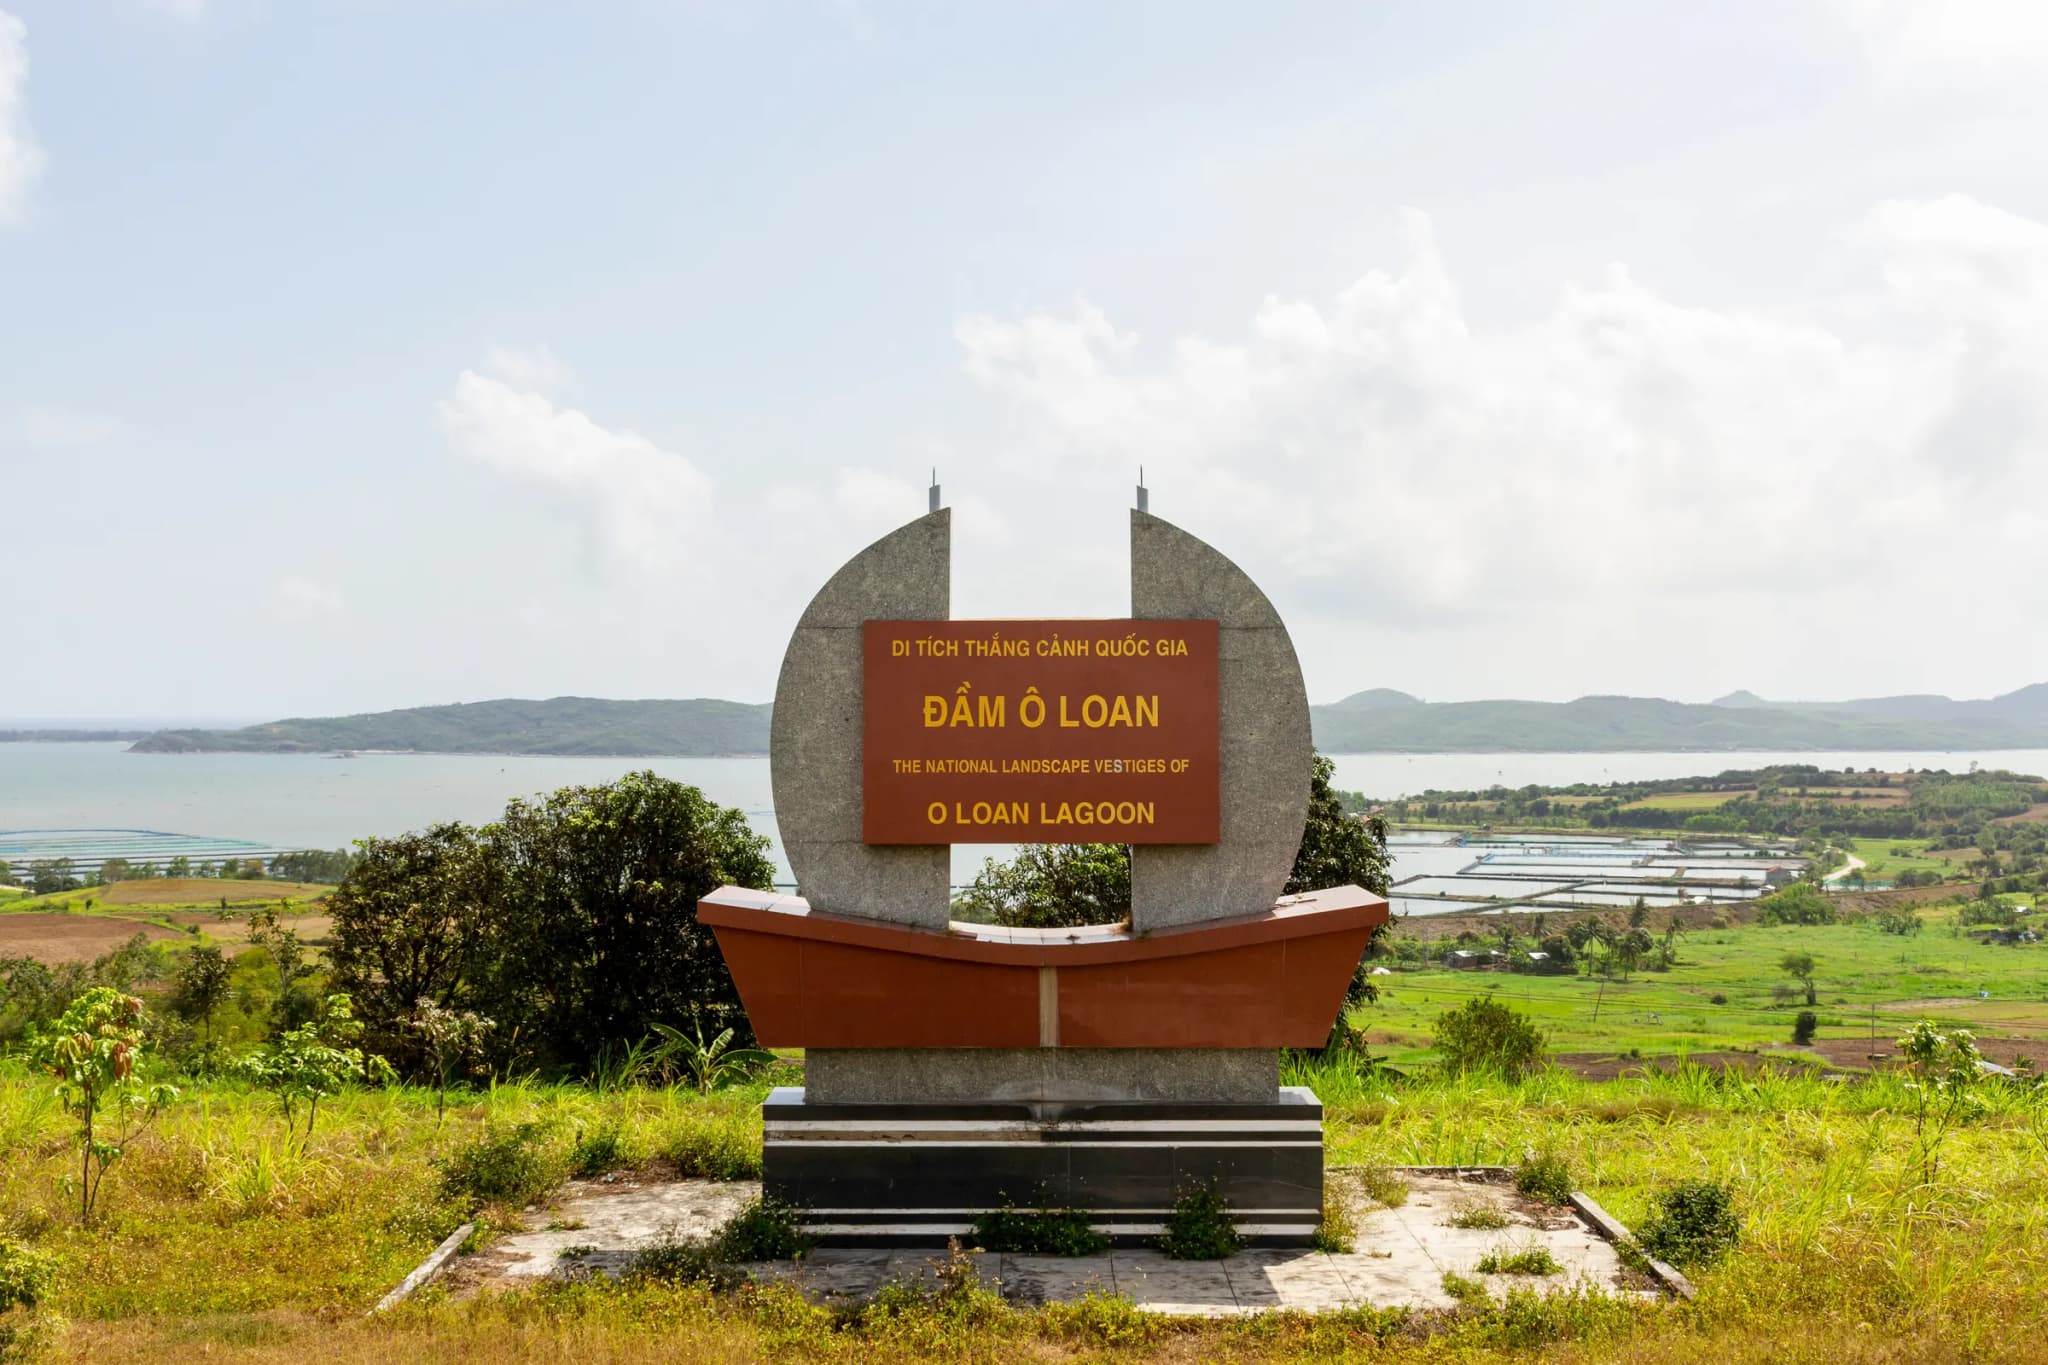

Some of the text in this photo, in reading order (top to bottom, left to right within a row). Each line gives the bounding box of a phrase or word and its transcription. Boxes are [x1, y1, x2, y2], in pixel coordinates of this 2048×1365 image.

[893, 632, 1188, 656] DI TÍCH THẮNG CẢNH QUỐC GIA
[923, 681, 1158, 728] ĐẦM Ô LOAN
[893, 759, 1189, 773] THE NATIONAL LANDSCAPE VESTIGES OF
[928, 802, 1154, 824] O LOAN LAGOON
